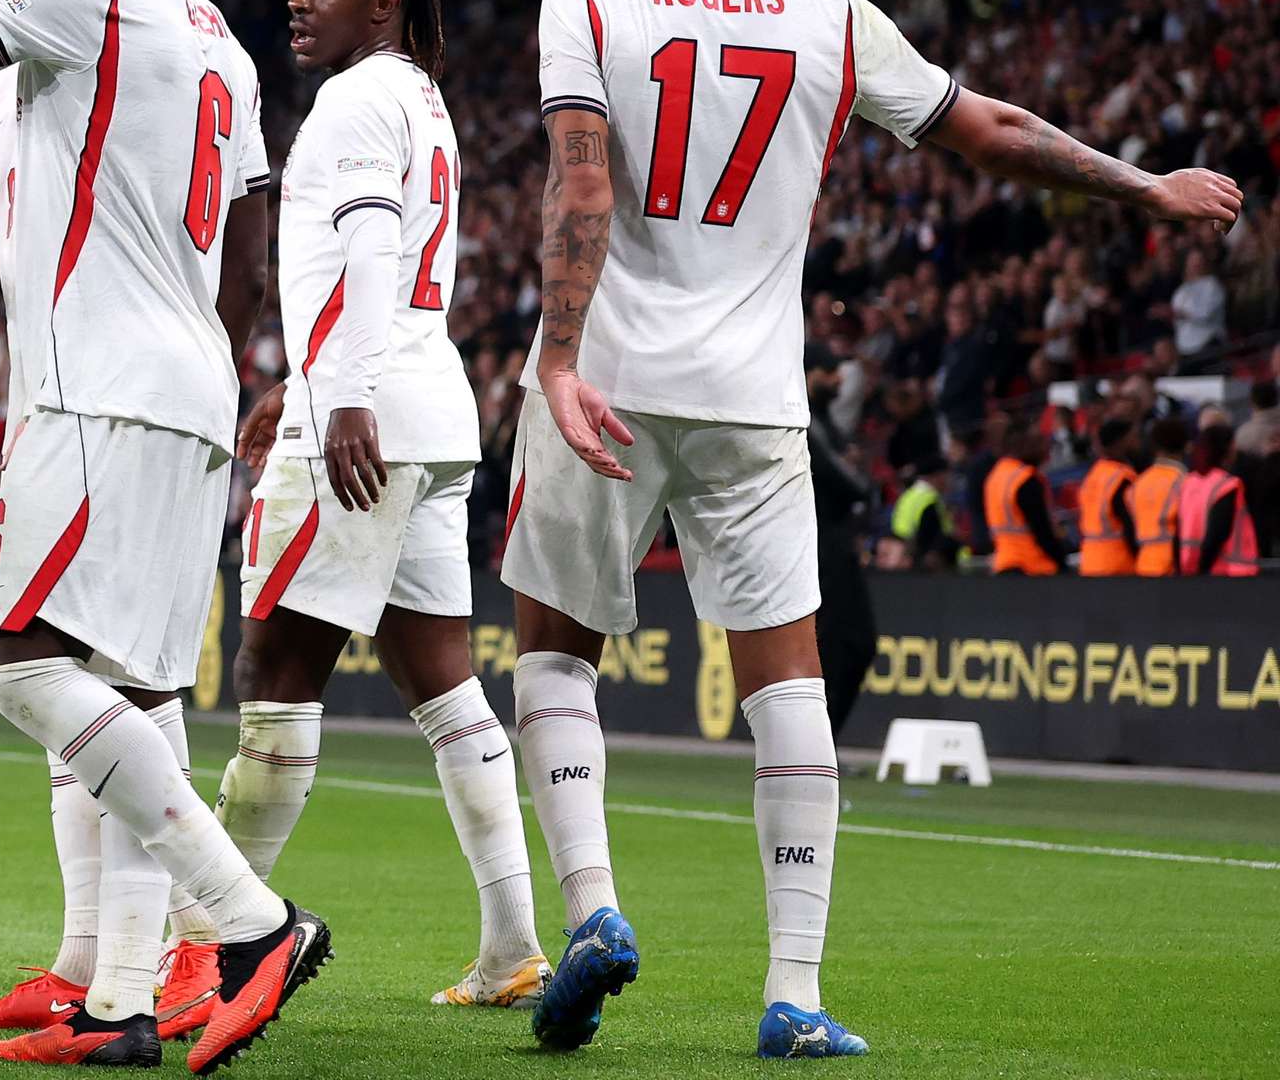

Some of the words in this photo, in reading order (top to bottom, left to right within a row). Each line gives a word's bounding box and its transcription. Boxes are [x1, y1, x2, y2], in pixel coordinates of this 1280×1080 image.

[565, 131, 605, 168] 51
[643, 37, 797, 227] 17
[183, 69, 232, 255] 6
[338, 159, 395, 170] FOUNDATION
[862, 635, 1077, 704] ODUCING
[1083, 642, 1211, 708] FAST
[1217, 647, 1280, 710] LA
[550, 766, 591, 785] ENG
[775, 846, 815, 865] ENG
